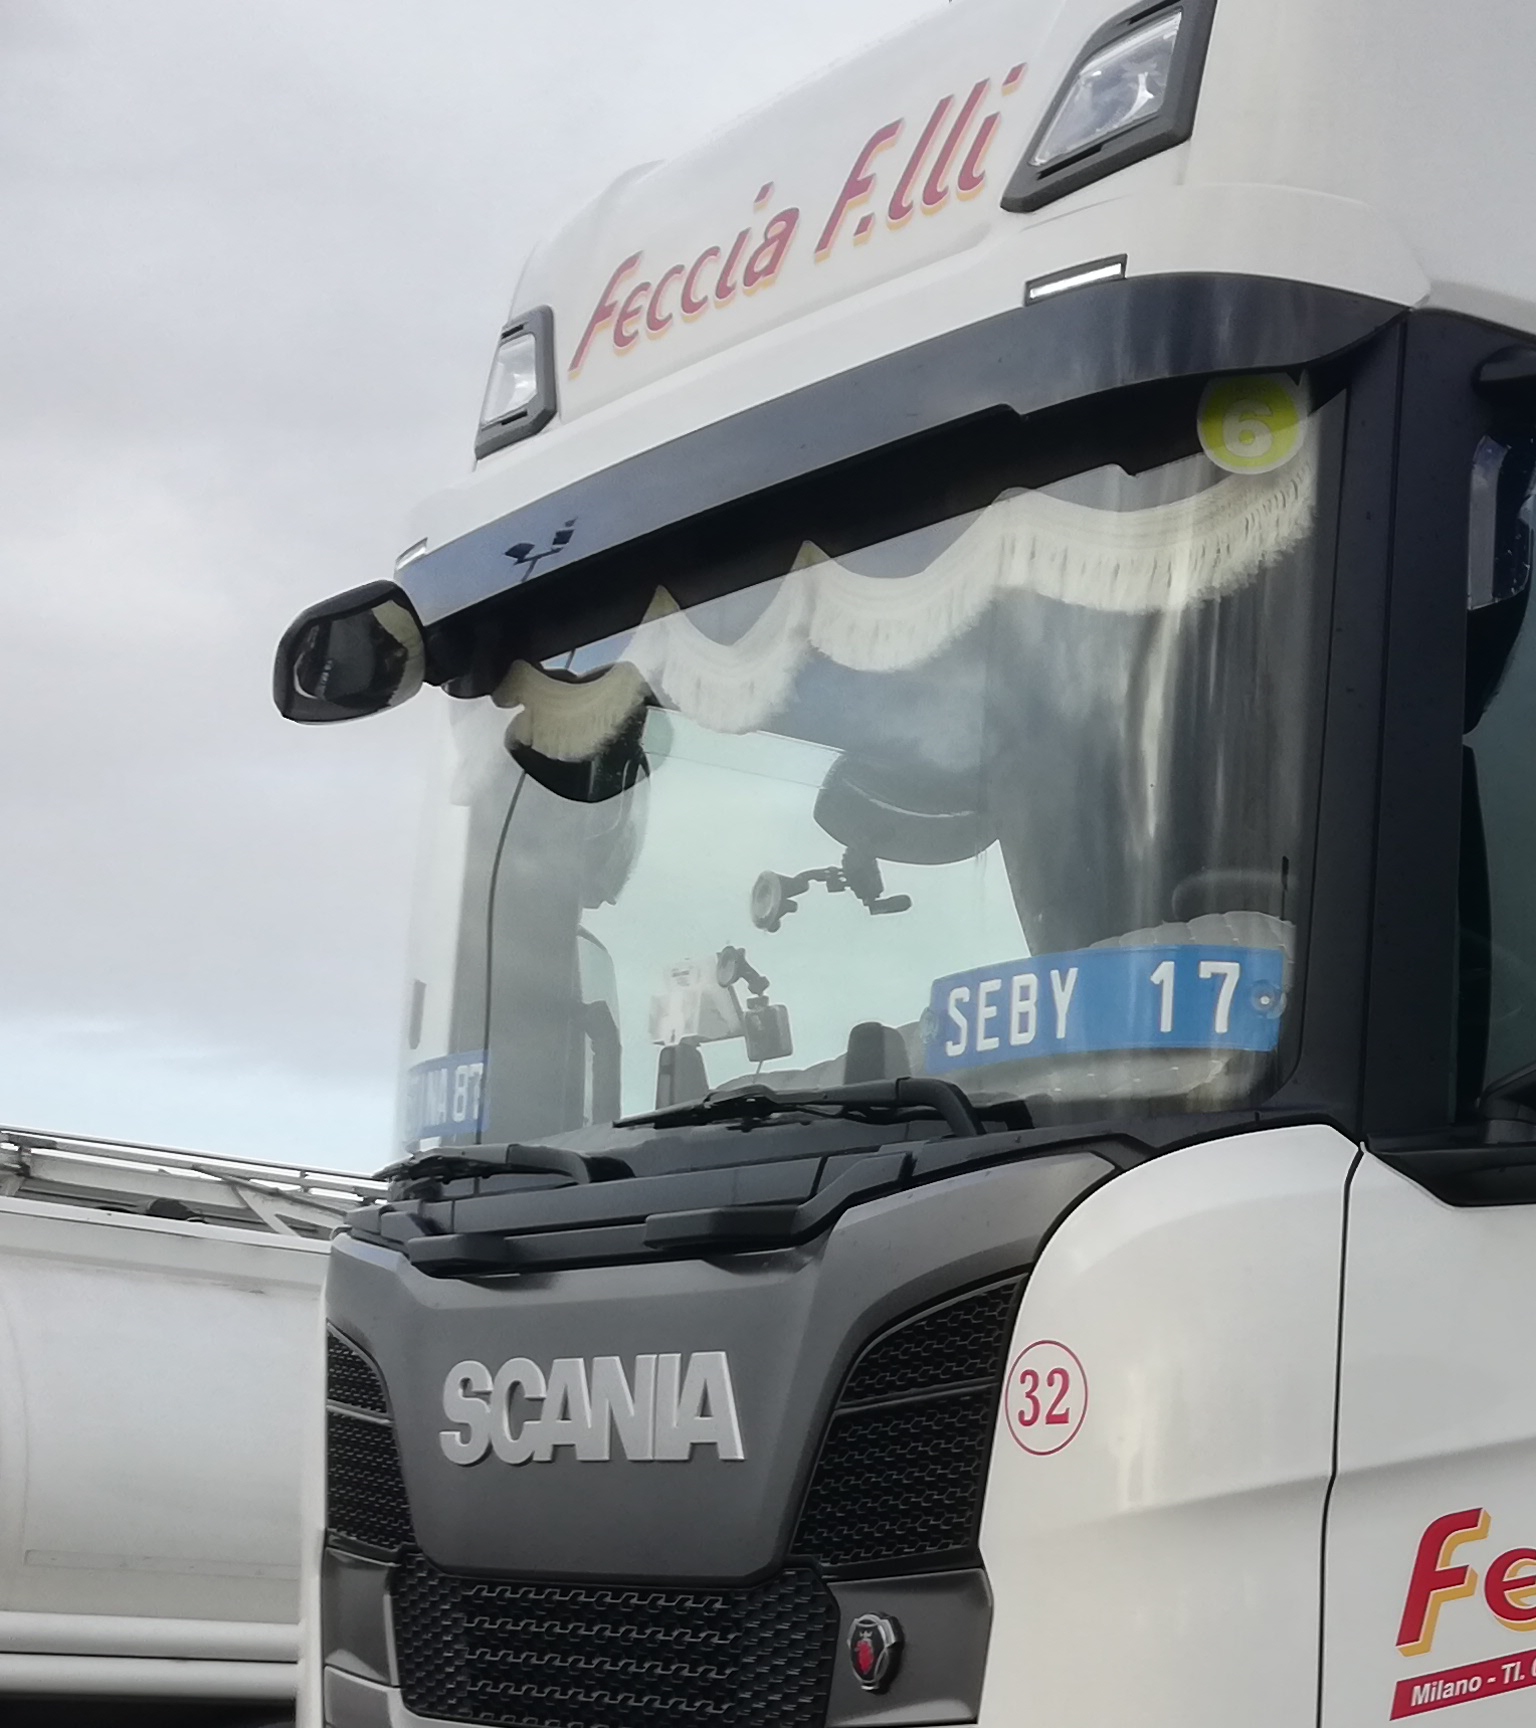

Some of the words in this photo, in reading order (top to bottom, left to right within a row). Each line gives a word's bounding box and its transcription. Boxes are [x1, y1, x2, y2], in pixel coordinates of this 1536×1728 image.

[567, 182, 801, 376] Feccia
[813, 62, 1028, 262] F.lli
[1222, 398, 1273, 458] 6
[945, 968, 1079, 1058] SEBY
[439, 1351, 747, 1466] SCANIA
[1017, 1367, 1072, 1427] 32
[1410, 1674, 1482, 1707] Milano
